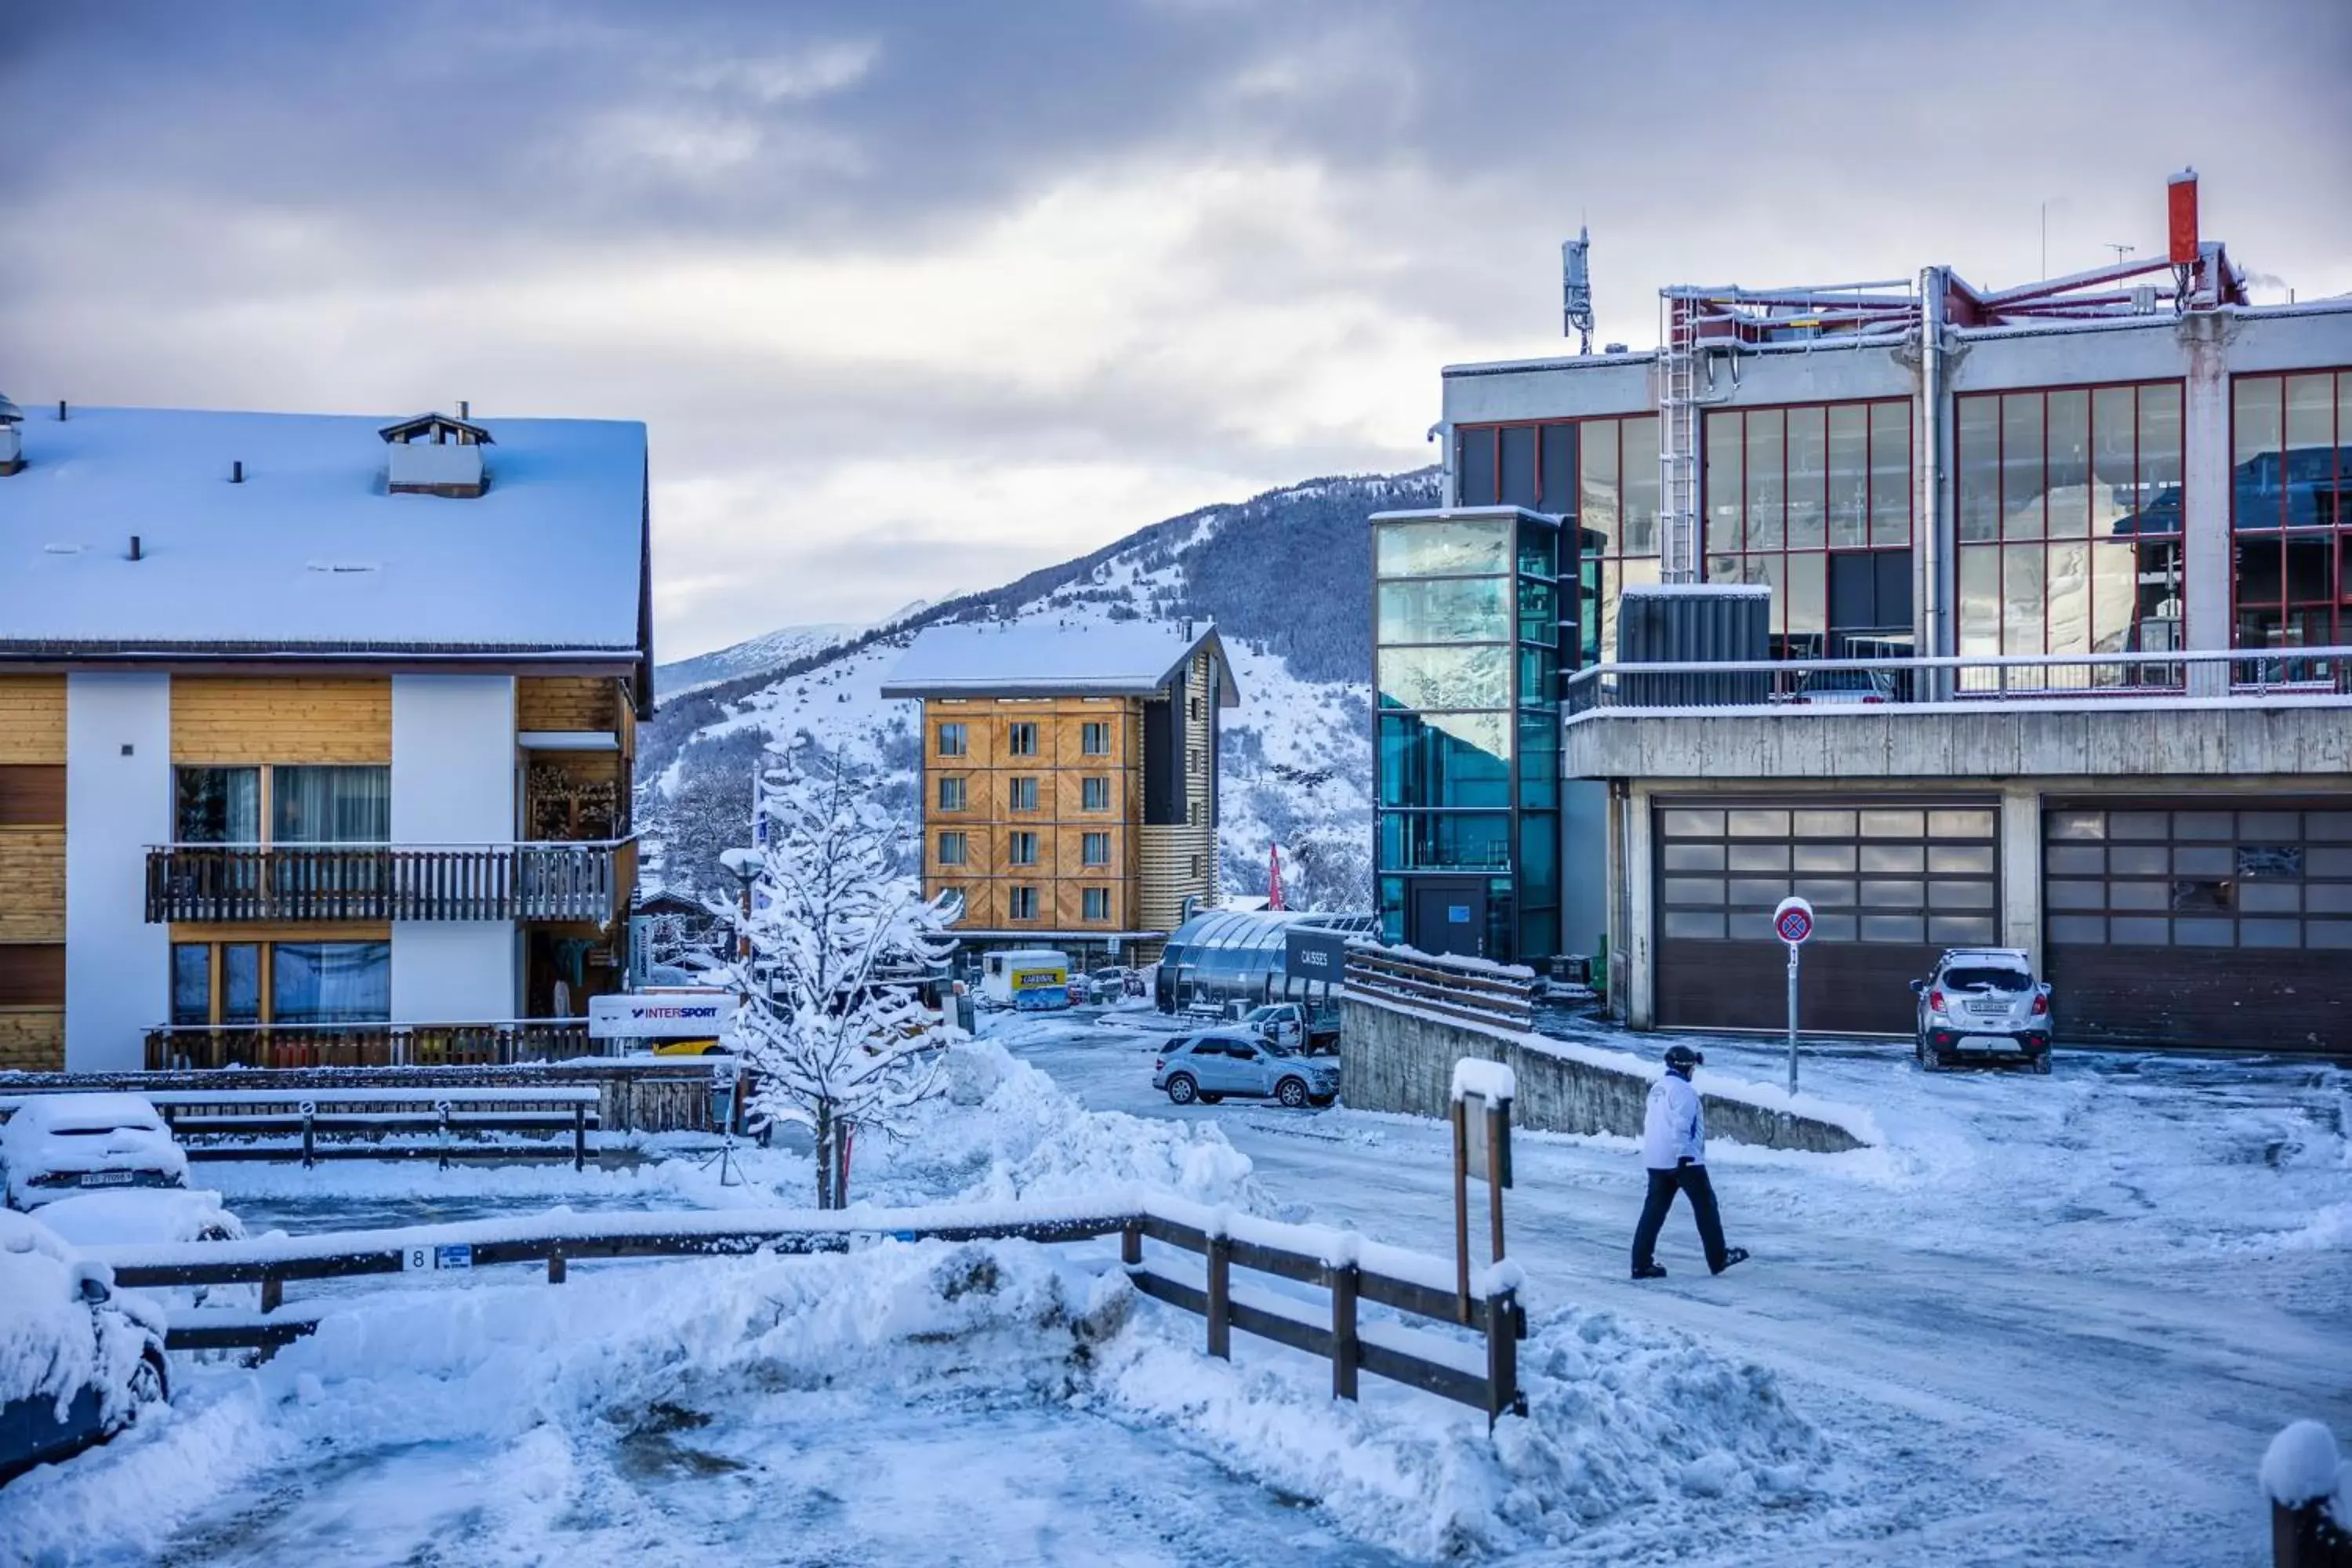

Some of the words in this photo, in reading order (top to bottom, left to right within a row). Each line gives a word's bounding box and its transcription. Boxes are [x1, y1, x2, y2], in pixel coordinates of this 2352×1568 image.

[1301, 949, 1327, 966] CAISSES
[645, 1007, 717, 1018] INTERSPORT
[412, 1250, 424, 1268] 8
